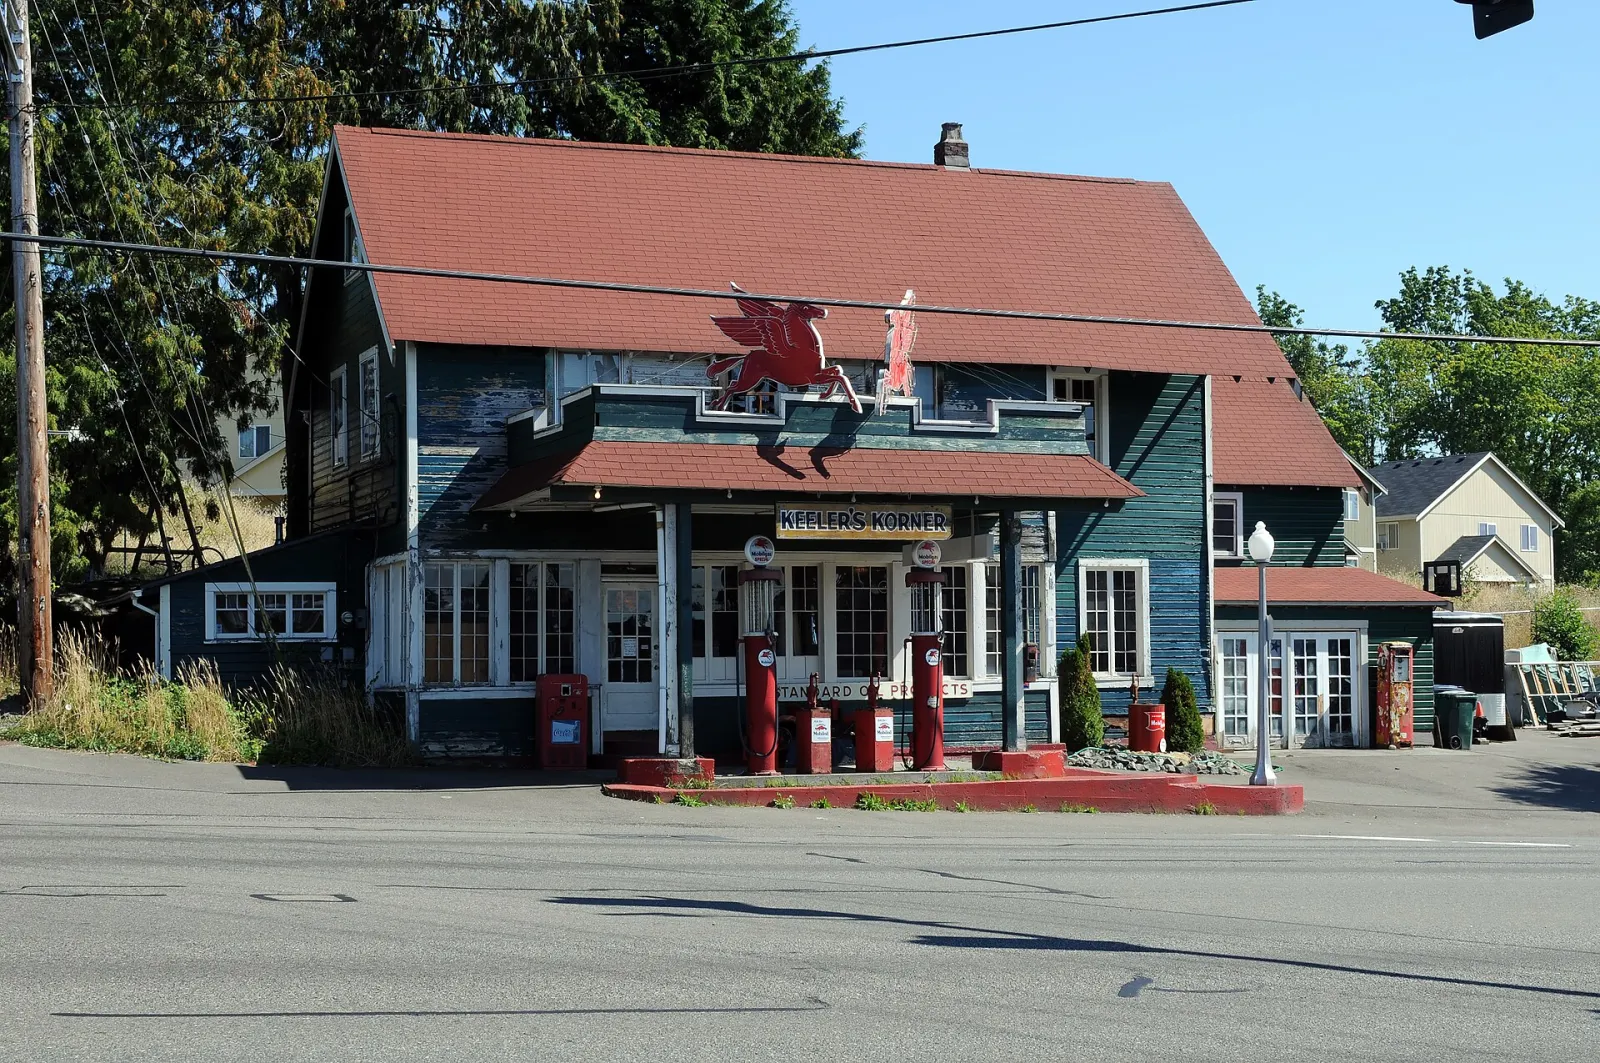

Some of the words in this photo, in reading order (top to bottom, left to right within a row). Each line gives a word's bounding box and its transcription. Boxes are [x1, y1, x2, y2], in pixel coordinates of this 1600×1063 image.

[780, 507, 867, 532] KEELER'S
[871, 511, 947, 532] KORNER
[859, 685, 884, 697] OL
[891, 684, 968, 696] PRCTS
